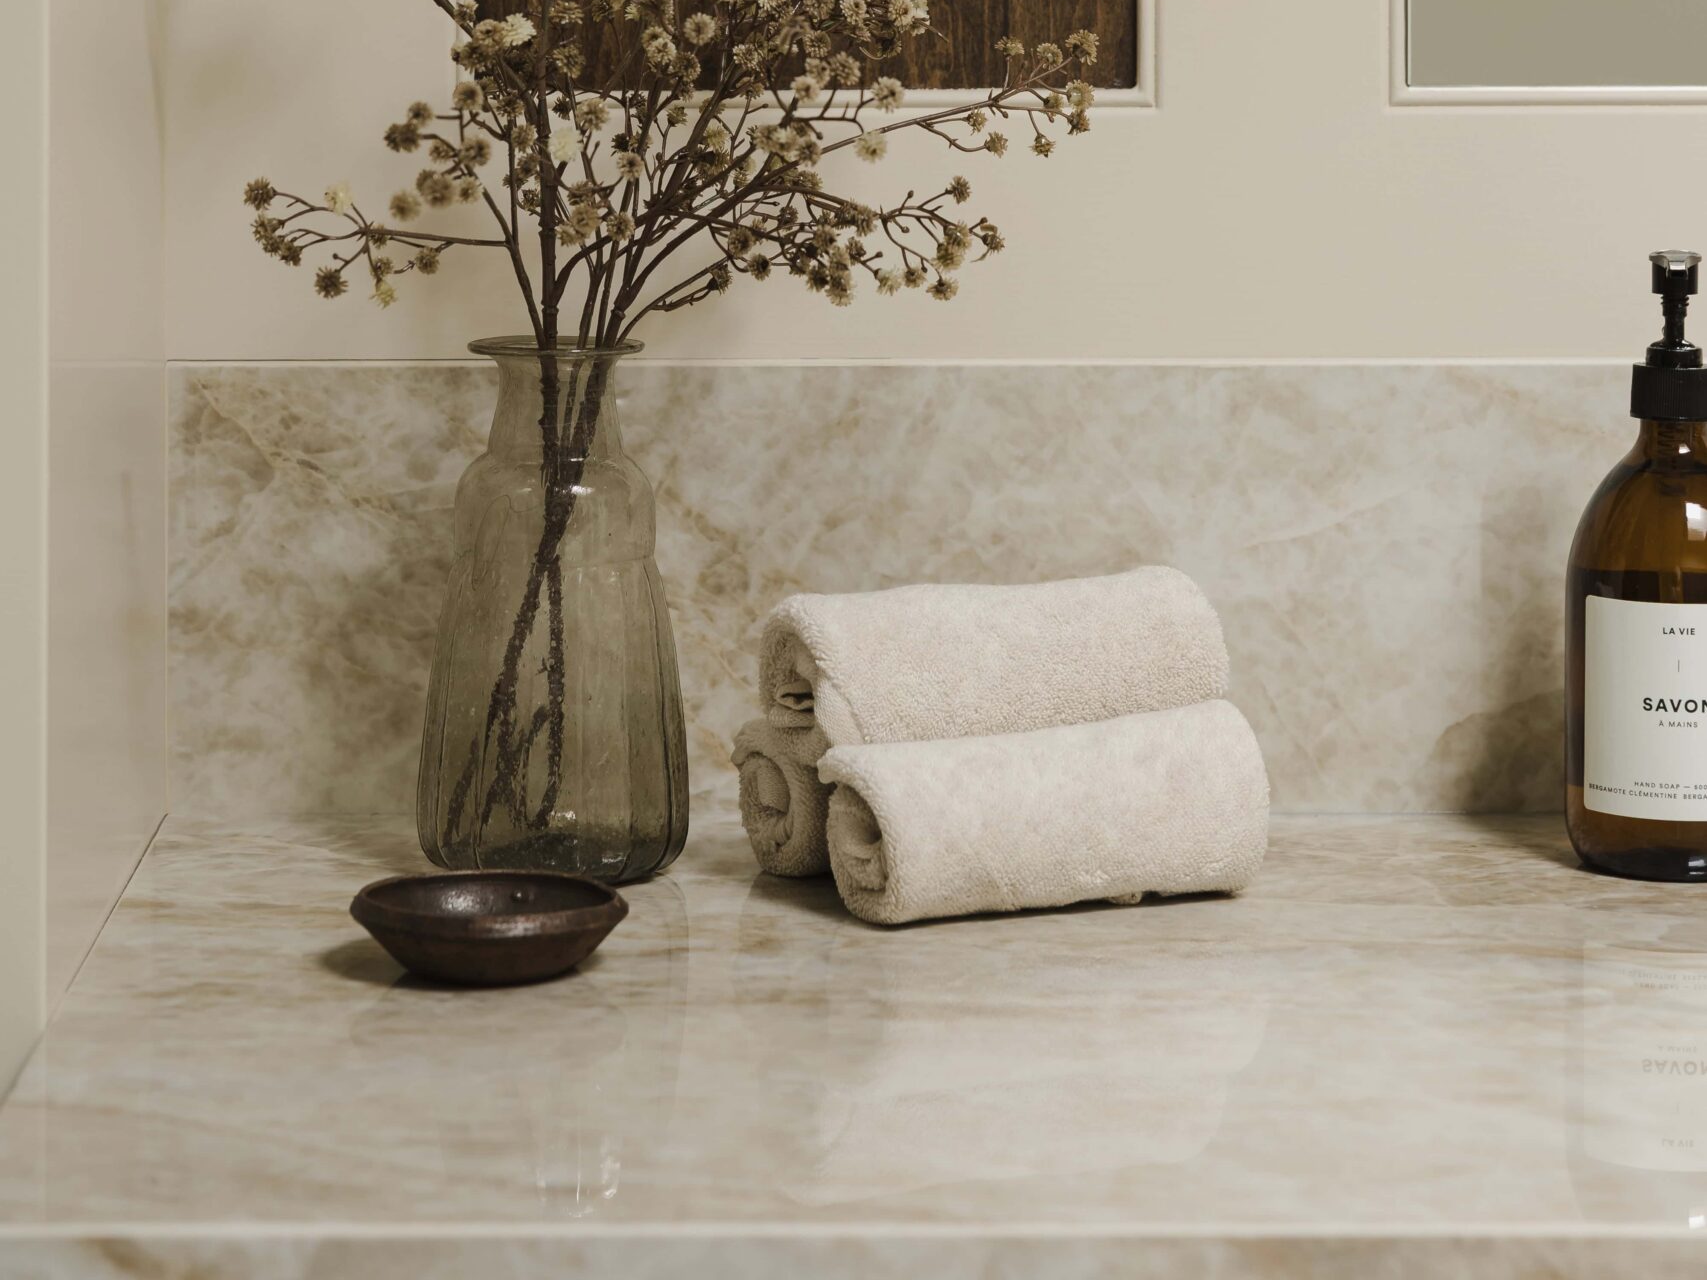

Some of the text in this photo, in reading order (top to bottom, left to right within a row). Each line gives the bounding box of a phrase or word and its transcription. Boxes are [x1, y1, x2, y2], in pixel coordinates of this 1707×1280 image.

[1662, 627, 1696, 636] LA VIE
[1668, 720, 1698, 728] MAINS
[1588, 783, 1626, 795] BERGAMOTE
[1634, 781, 1656, 789] HAND
